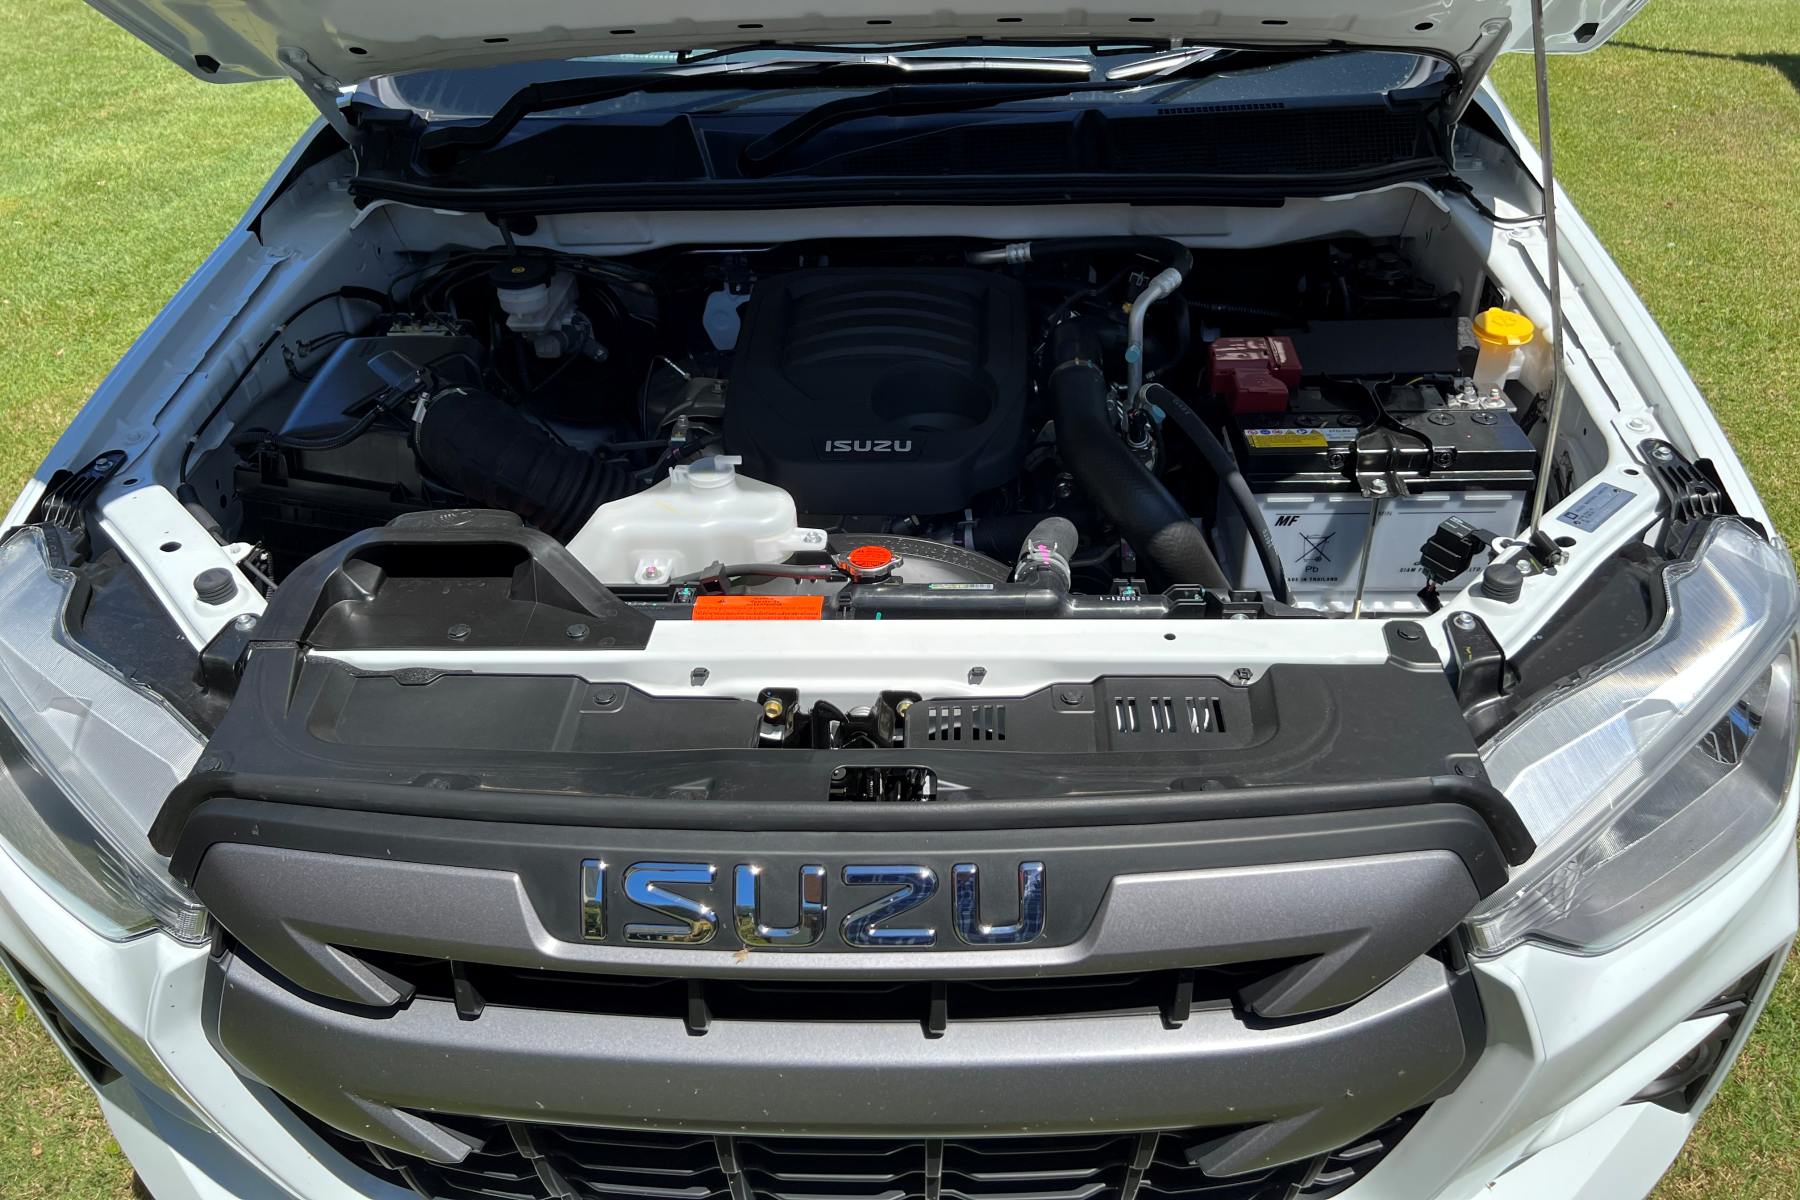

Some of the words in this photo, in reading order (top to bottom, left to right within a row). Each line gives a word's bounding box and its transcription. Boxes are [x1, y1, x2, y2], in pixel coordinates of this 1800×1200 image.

[825, 440, 912, 452] ISUZU
[1274, 515, 1300, 527] MF
[580, 858, 1047, 946] ISUZU
